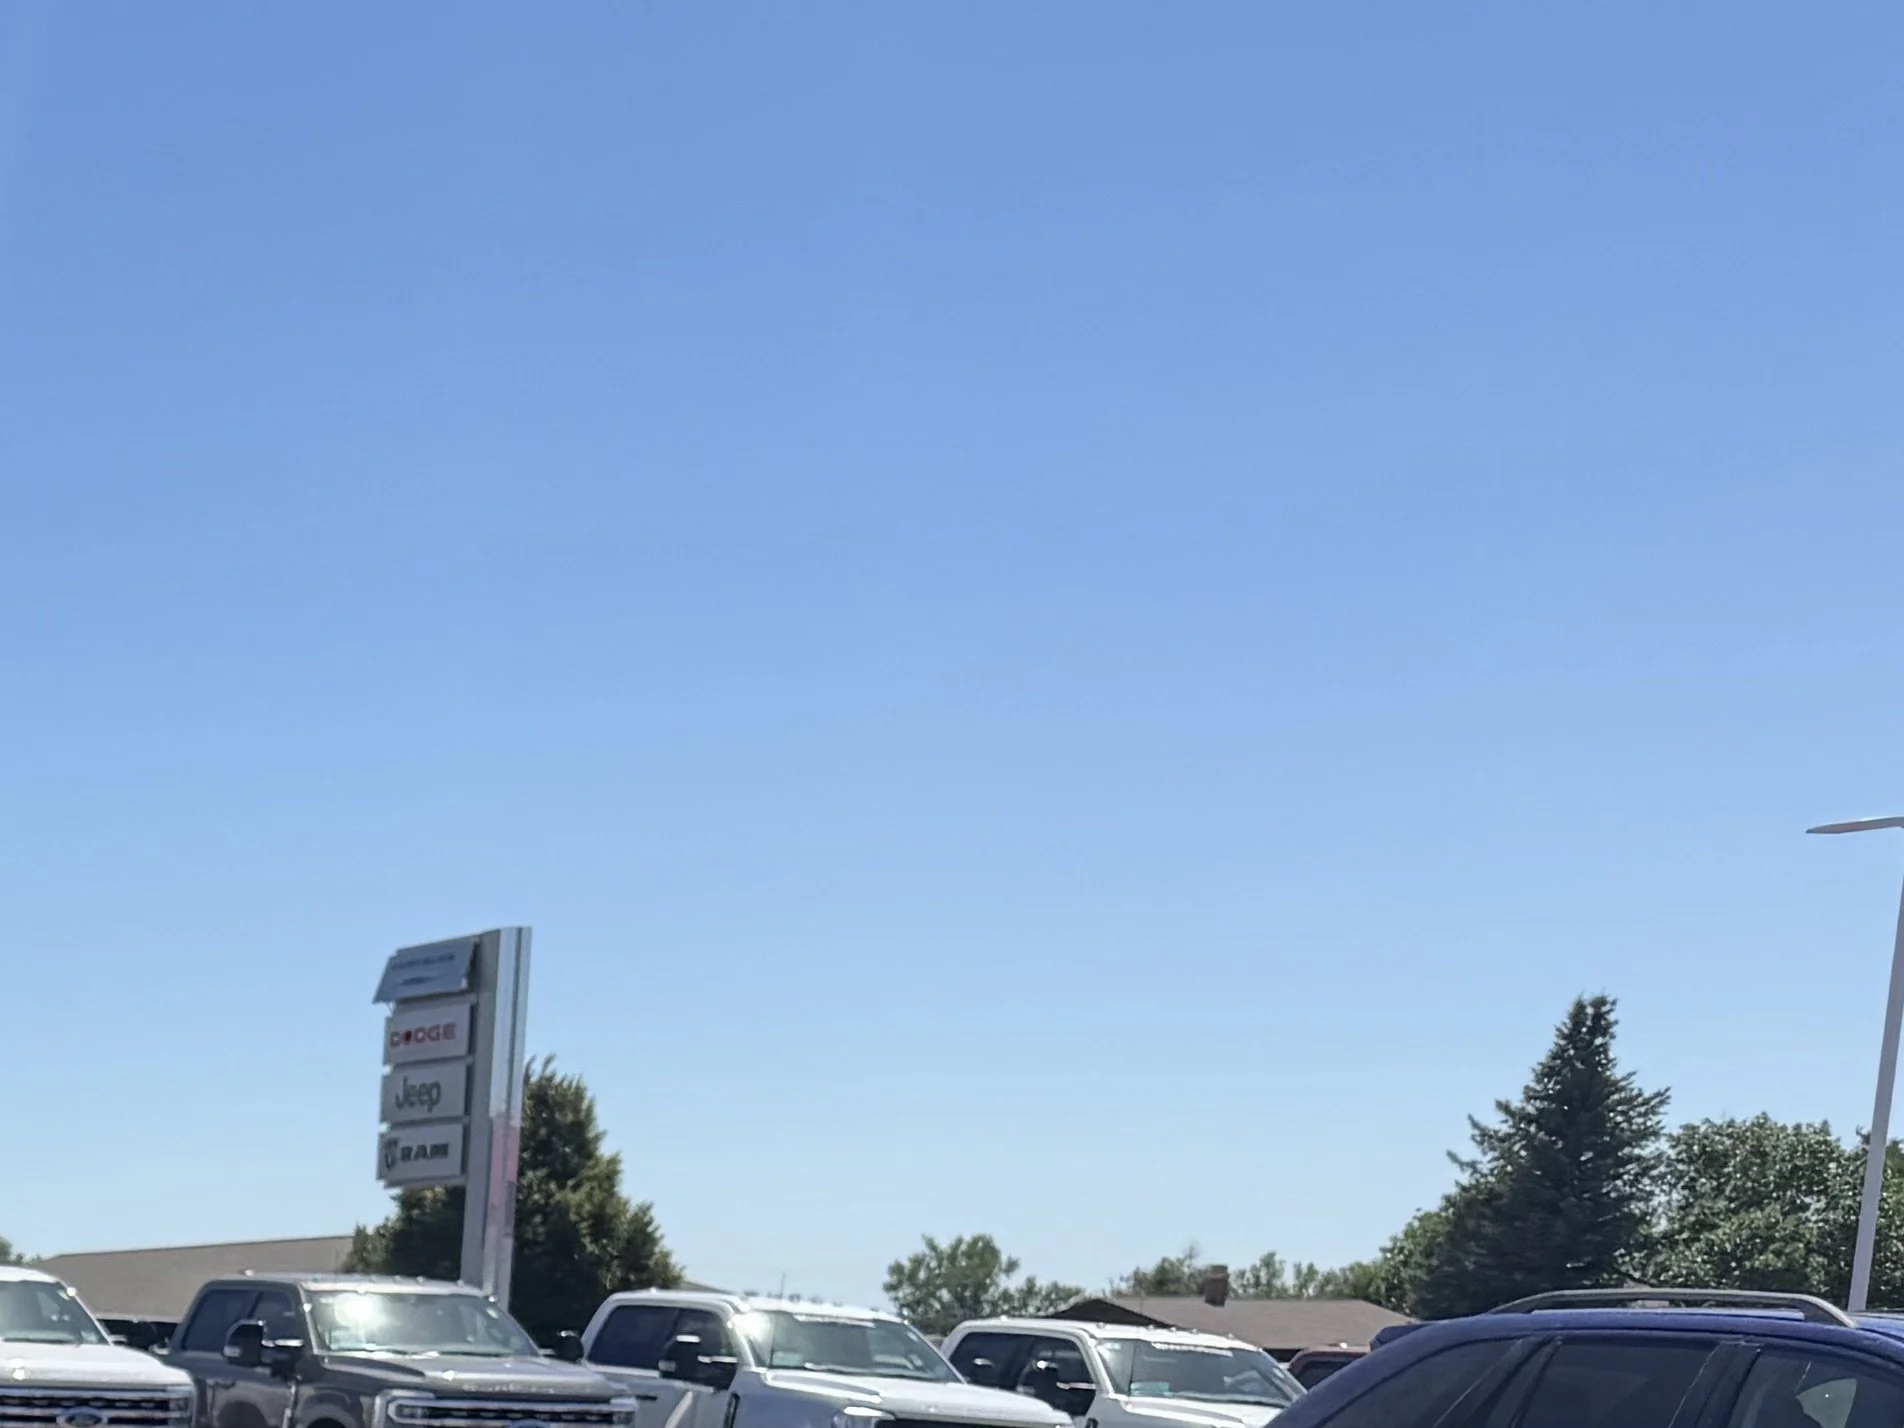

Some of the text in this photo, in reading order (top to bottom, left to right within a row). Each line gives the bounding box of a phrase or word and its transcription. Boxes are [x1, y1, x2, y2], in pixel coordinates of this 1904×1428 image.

[390, 1021, 457, 1047] DODGE
[395, 1076, 441, 1113] Jeep
[400, 1143, 449, 1162] RAM
